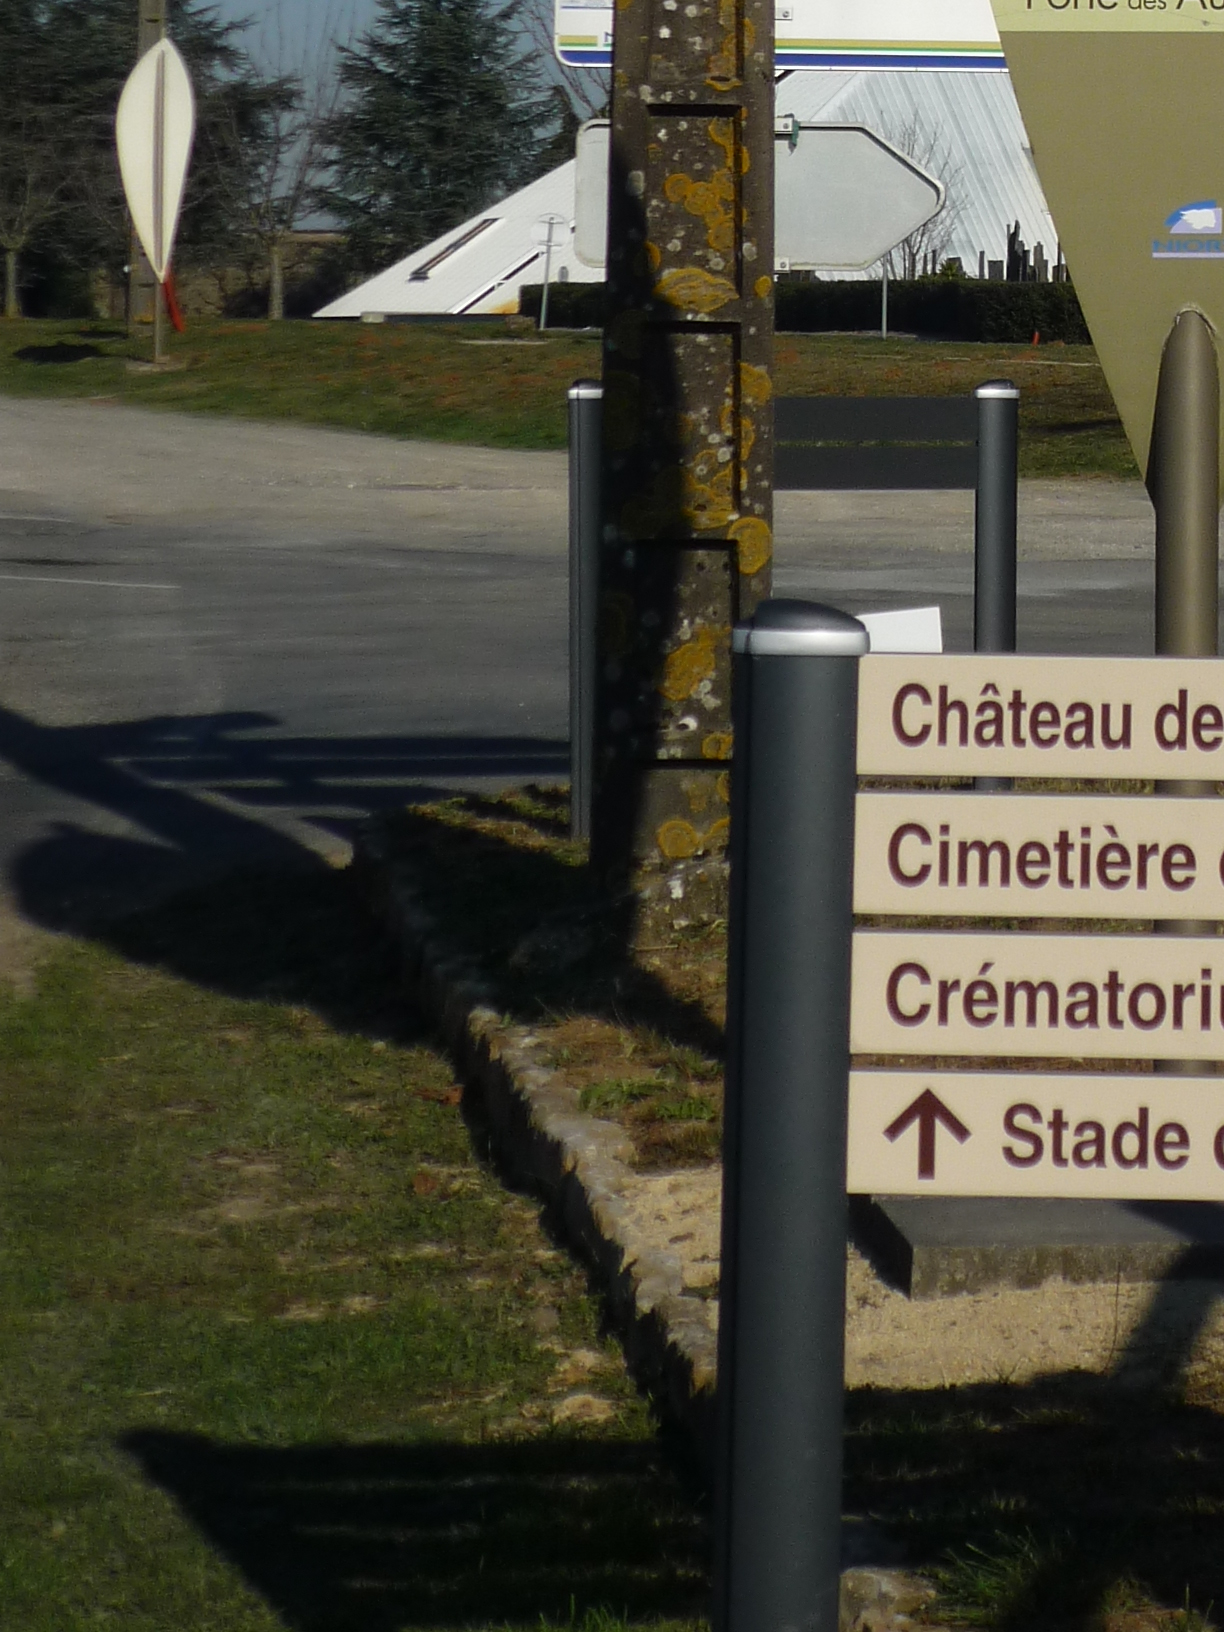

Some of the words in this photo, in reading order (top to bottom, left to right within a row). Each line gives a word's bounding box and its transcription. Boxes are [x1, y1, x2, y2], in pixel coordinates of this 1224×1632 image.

[892, 682, 1132, 750] Château
[1154, 688, 1224, 752] de
[888, 822, 1197, 891] Cimetière
[1002, 1102, 1190, 1171] Stade
